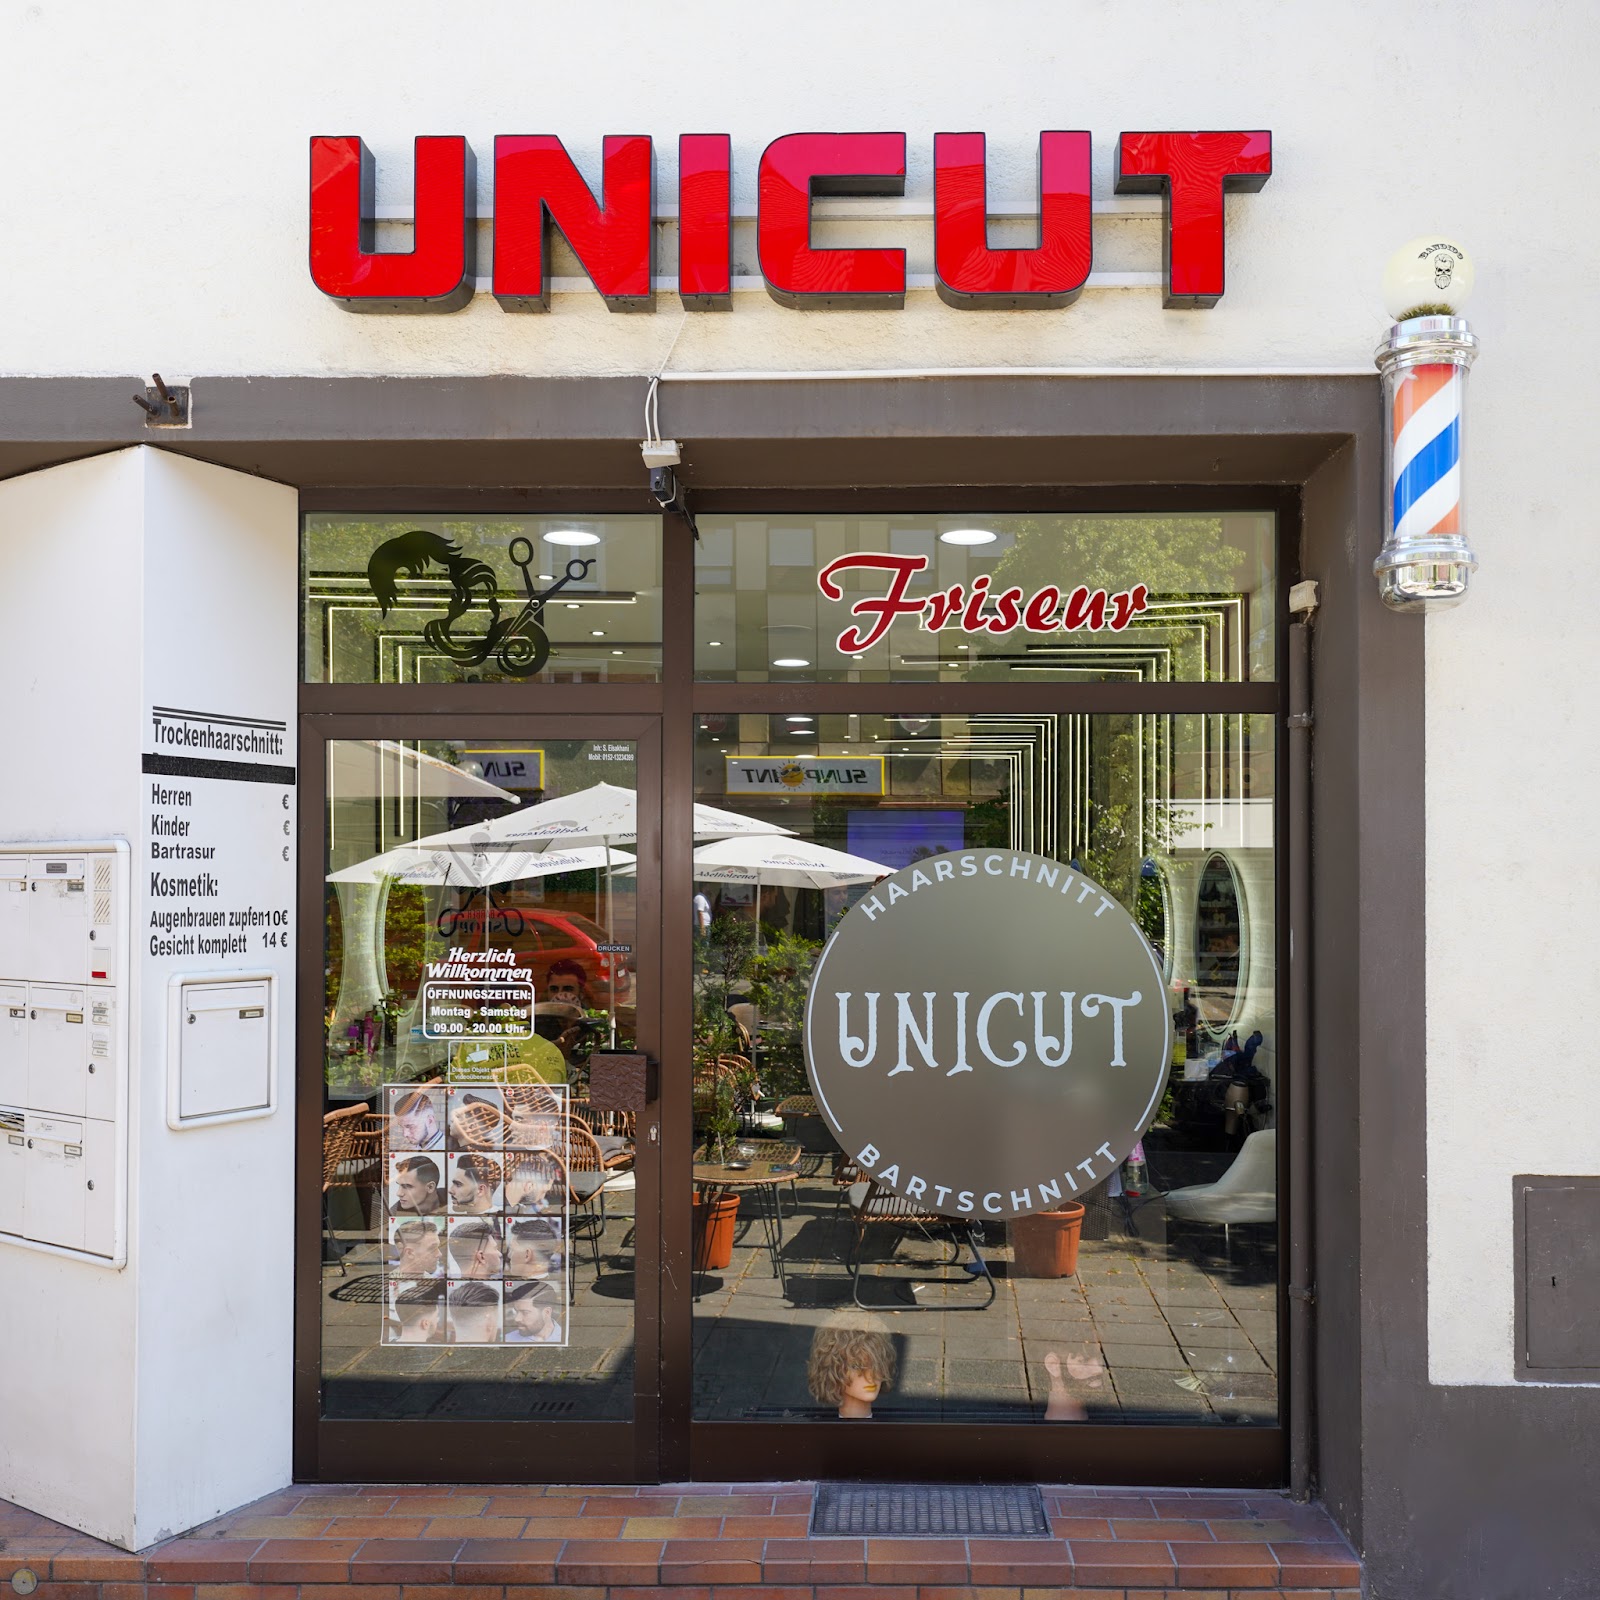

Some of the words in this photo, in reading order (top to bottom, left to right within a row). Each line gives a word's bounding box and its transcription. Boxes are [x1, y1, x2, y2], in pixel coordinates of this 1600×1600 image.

[309, 129, 1273, 308] UNICUT
[1417, 243, 1464, 260] BANDIDO
[817, 551, 1151, 655] Friseur
[153, 718, 283, 755] Trockenhaarschnitt:
[152, 783, 192, 806] Herren
[282, 794, 289, 810] €
[151, 814, 190, 837] Kinder
[283, 820, 290, 836] €
[151, 842, 216, 860] Bartrasur
[282, 846, 290, 862] €
[151, 872, 218, 896] Kosmetik:
[860, 854, 1115, 921] HAARSCHNITT
[150, 907, 226, 933] Augenbrauen
[150, 934, 194, 956] Gesicht
[198, 933, 247, 958] komplett
[262, 932, 277, 948] 14
[280, 932, 288, 948] €
[448, 947, 516, 966] Herzlich
[425, 963, 533, 982] Willkommen
[427, 987, 532, 1000] ÖFFNUNGSZEITEN:
[431, 1007, 471, 1018] Montag
[480, 1007, 527, 1018] Samstag
[433, 1023, 463, 1033] 09.00
[472, 1023, 502, 1033] 20.00
[504, 1023, 527, 1033] Uhr.
[835, 990, 1142, 1077] UNICUT
[856, 1141, 1117, 1213] BARTSCHNITT
